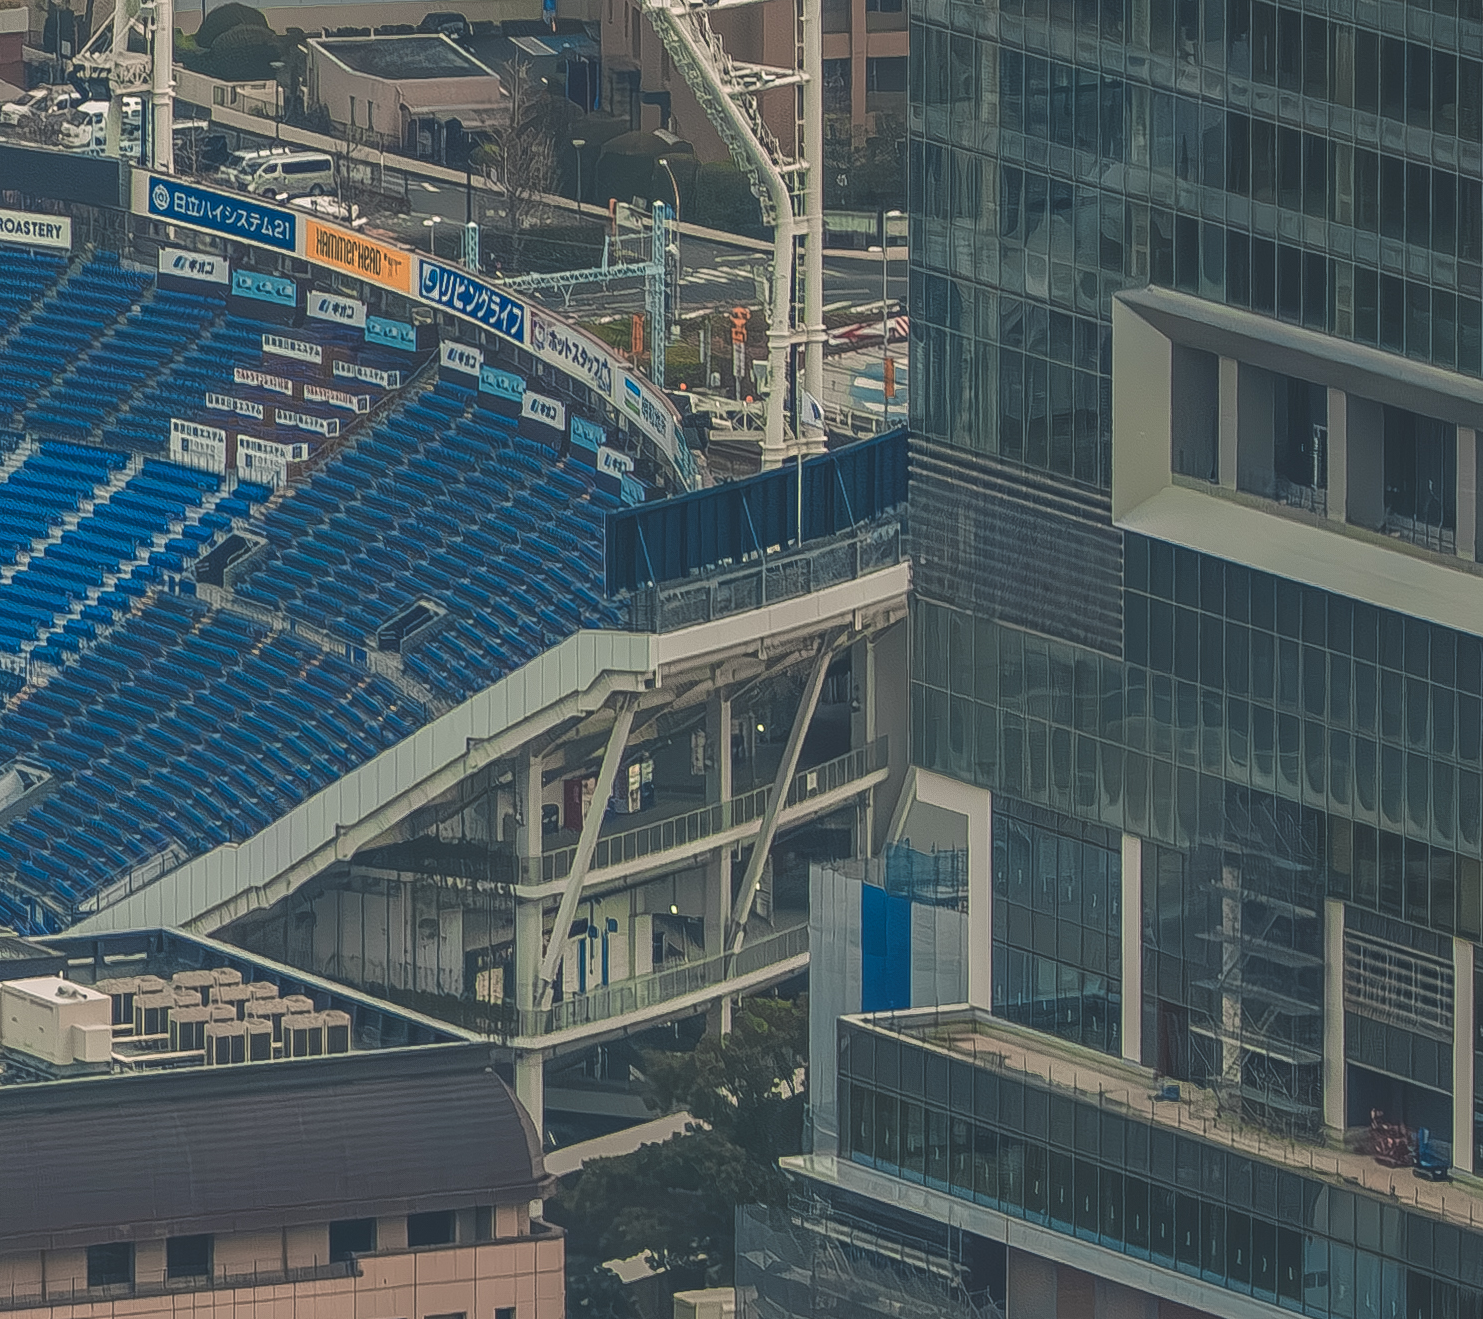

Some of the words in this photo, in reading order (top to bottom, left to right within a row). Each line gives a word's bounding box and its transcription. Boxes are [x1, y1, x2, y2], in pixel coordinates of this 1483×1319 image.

[173, 192, 290, 240] 日立ハイシステム21
[441, 270, 523, 335] リビングライフ
